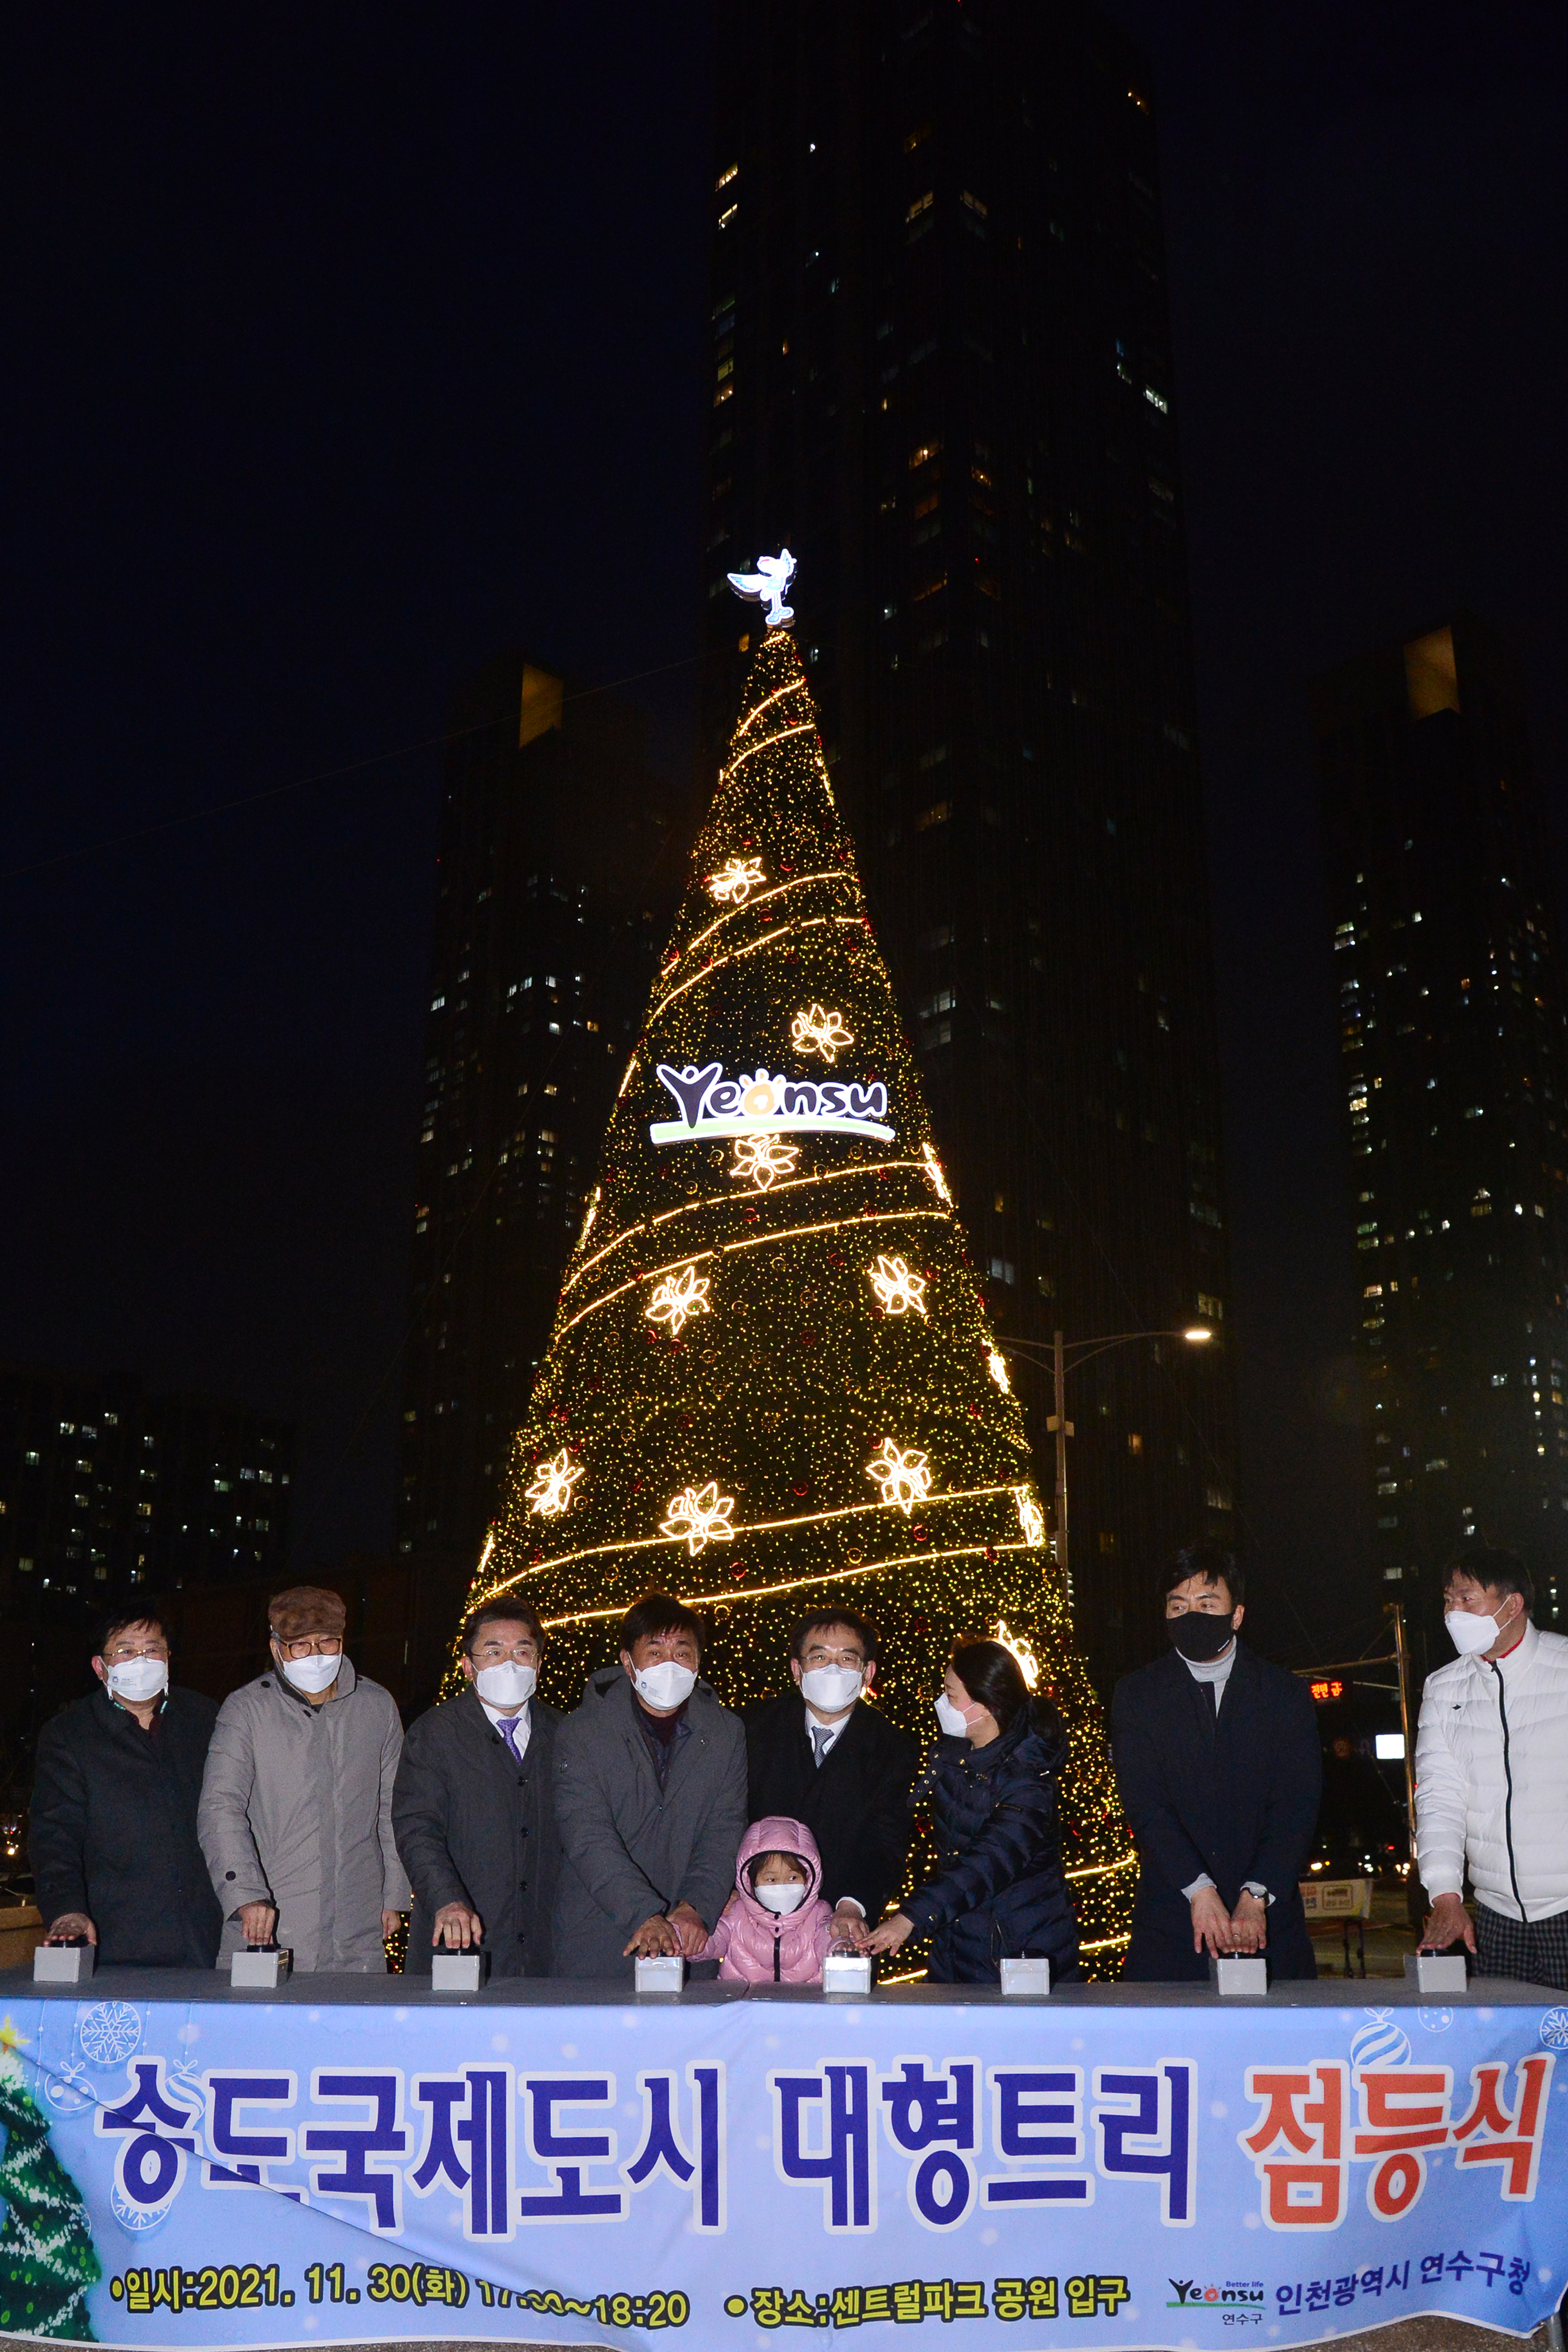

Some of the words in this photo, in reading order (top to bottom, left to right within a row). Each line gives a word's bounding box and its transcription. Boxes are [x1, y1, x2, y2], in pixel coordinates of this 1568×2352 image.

[658, 1064, 887, 1129] Yeonsu
[99, 2062, 721, 2235] 송도국제도시
[773, 2061, 1191, 2228] 대형트리
[1245, 2057, 1548, 2225] 점등식
[125, 2266, 293, 2311] 일시:2021.
[307, 2265, 358, 2301] 11.
[371, 2266, 468, 2306] 30(화)
[753, 2280, 987, 2327] 장소:센트럴파크
[994, 2278, 1057, 2319] 공원
[1067, 2277, 1128, 2315] 입구
[1168, 2278, 1264, 2304] Yeonsu
[1275, 2260, 1410, 2316] 인천광역시
[1420, 2250, 1531, 2296] 연수구청
[1221, 2313, 1263, 2326] 연수구
